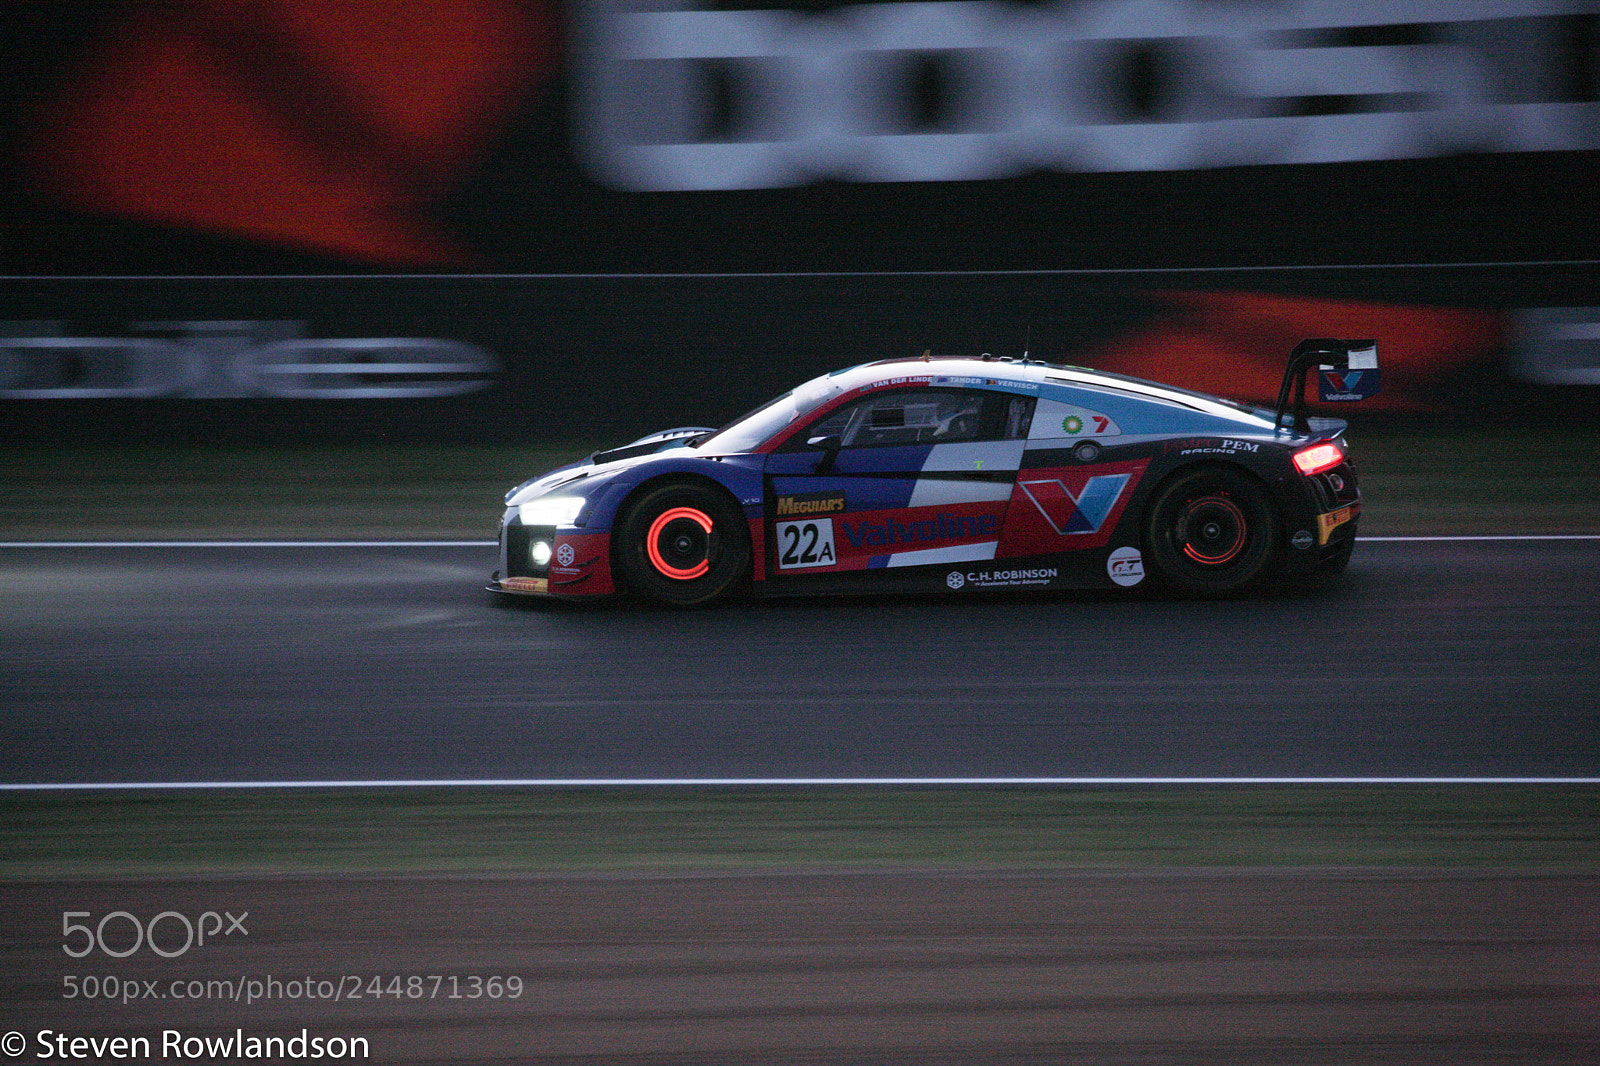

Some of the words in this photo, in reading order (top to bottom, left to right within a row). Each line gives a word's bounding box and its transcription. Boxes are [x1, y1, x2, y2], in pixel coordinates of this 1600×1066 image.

[872, 379, 889, 389] VAN
[890, 377, 907, 386] DER
[908, 376, 933, 384] LINDE
[950, 376, 982, 385] TANDER
[997, 380, 1038, 390] VERVISCH
[1092, 416, 1110, 433] 7
[1180, 447, 1237, 456] RACING
[1221, 439, 1260, 453] PEM
[841, 512, 999, 548] Valvoline
